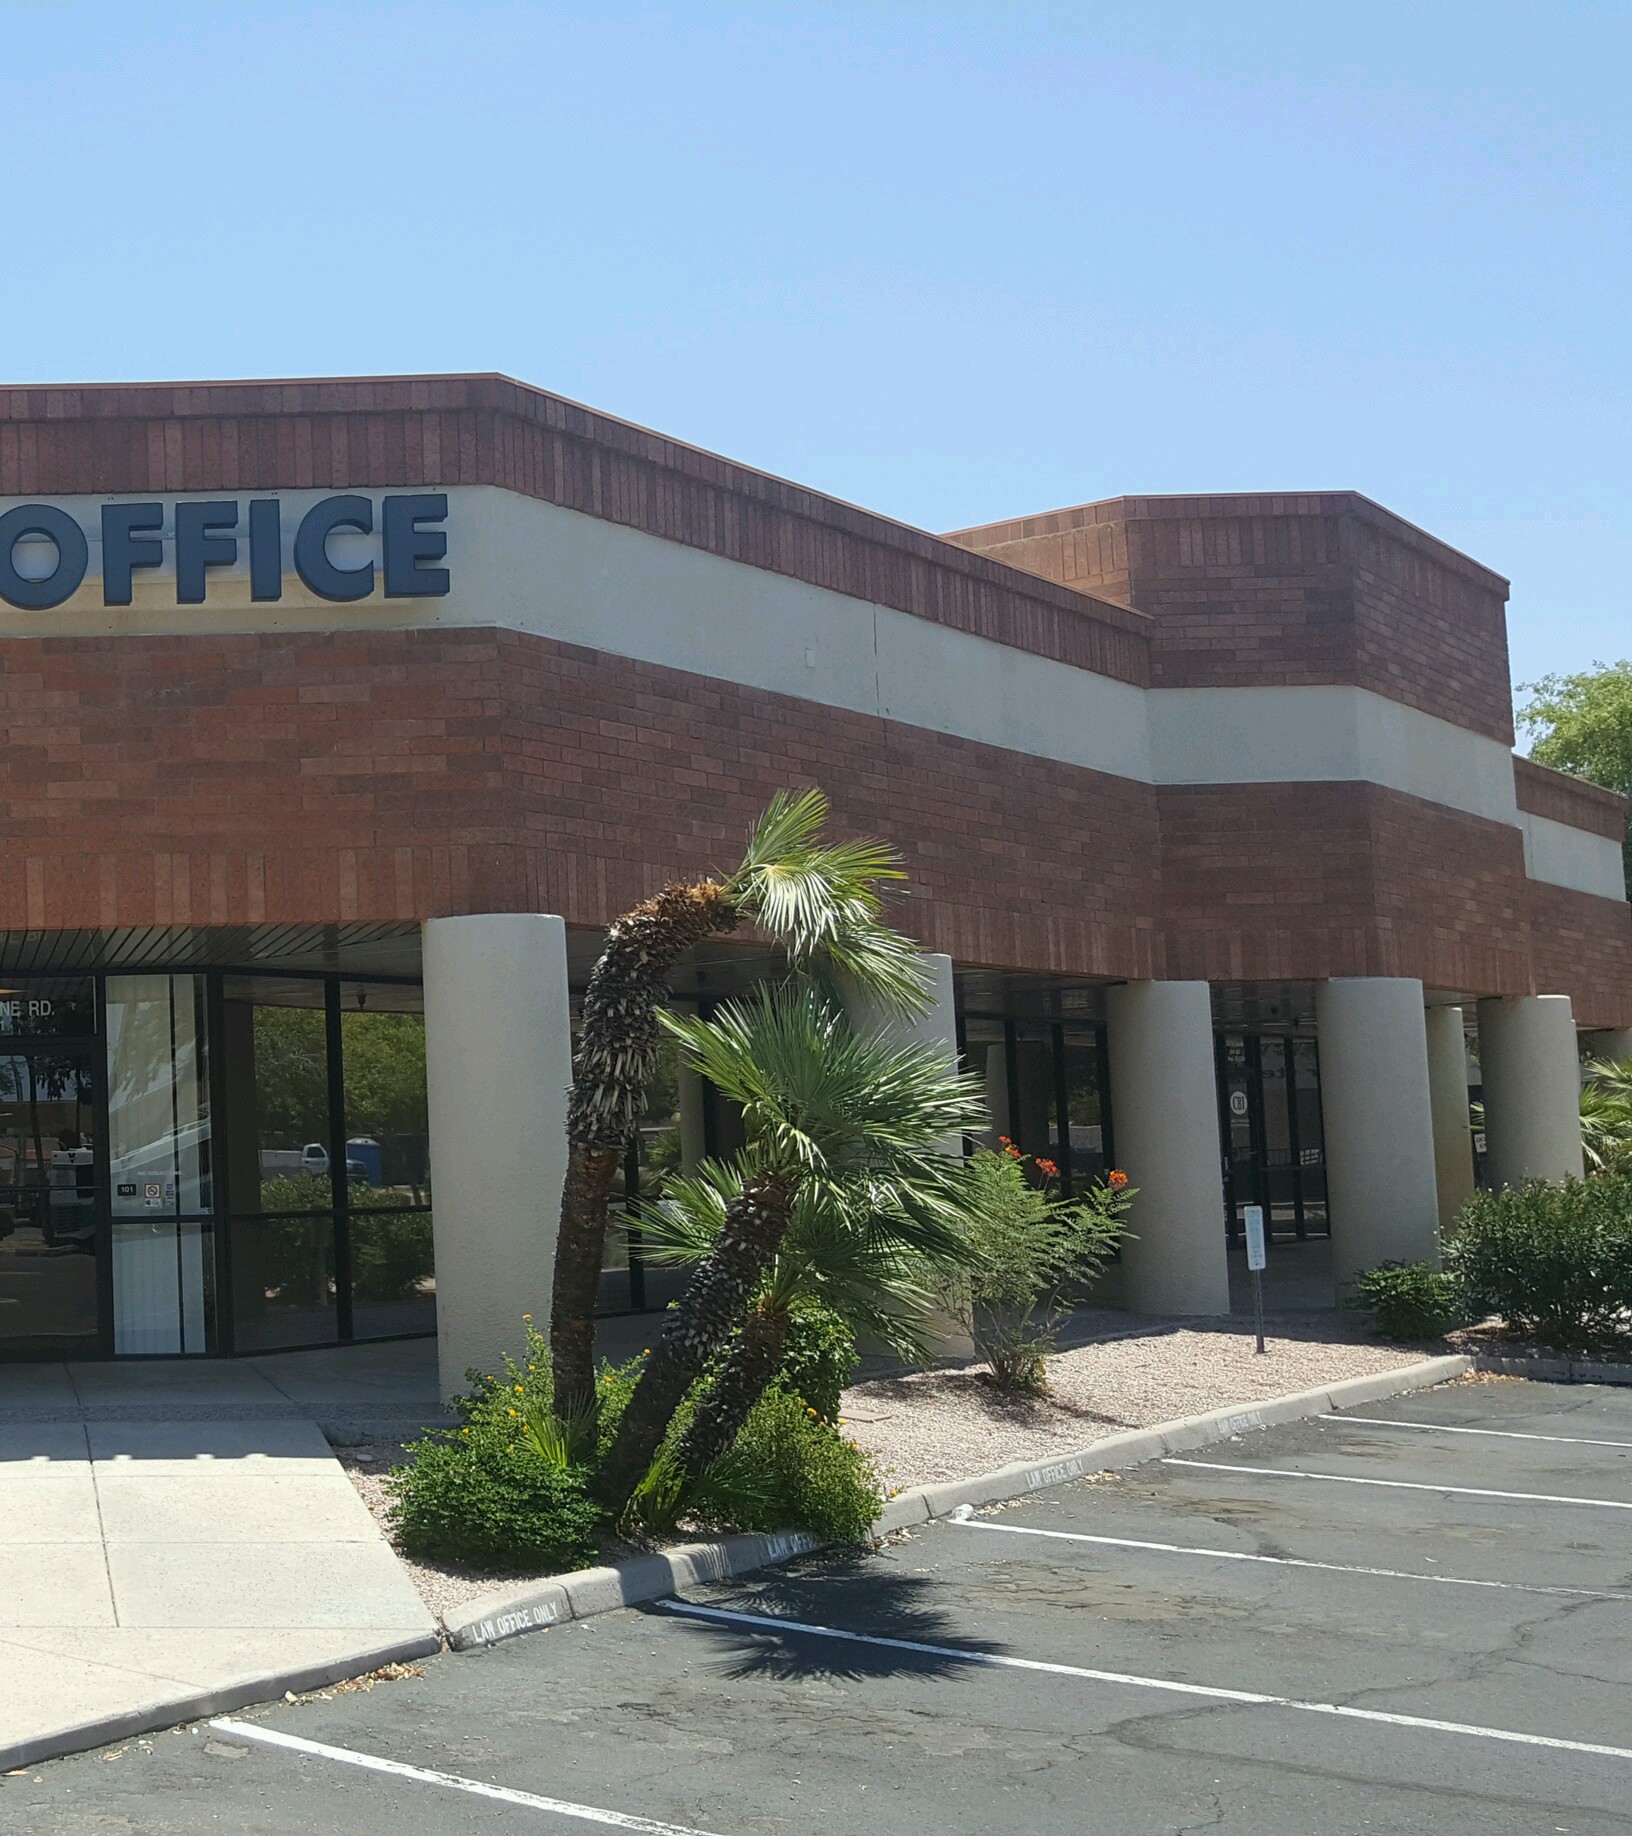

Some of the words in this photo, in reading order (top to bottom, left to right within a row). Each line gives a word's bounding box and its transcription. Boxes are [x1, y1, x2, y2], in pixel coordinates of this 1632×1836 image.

[28, 1000, 56, 1017] RD.
[1024, 1469, 1044, 1491] LAW
[1041, 1463, 1067, 1483] OFFICE
[1065, 1457, 1085, 1477] ONLY
[765, 1537, 789, 1559] LAW
[471, 1619, 497, 1644] LAW
[495, 1609, 533, 1636] OFFICE
[532, 1601, 559, 1624] ONLY
